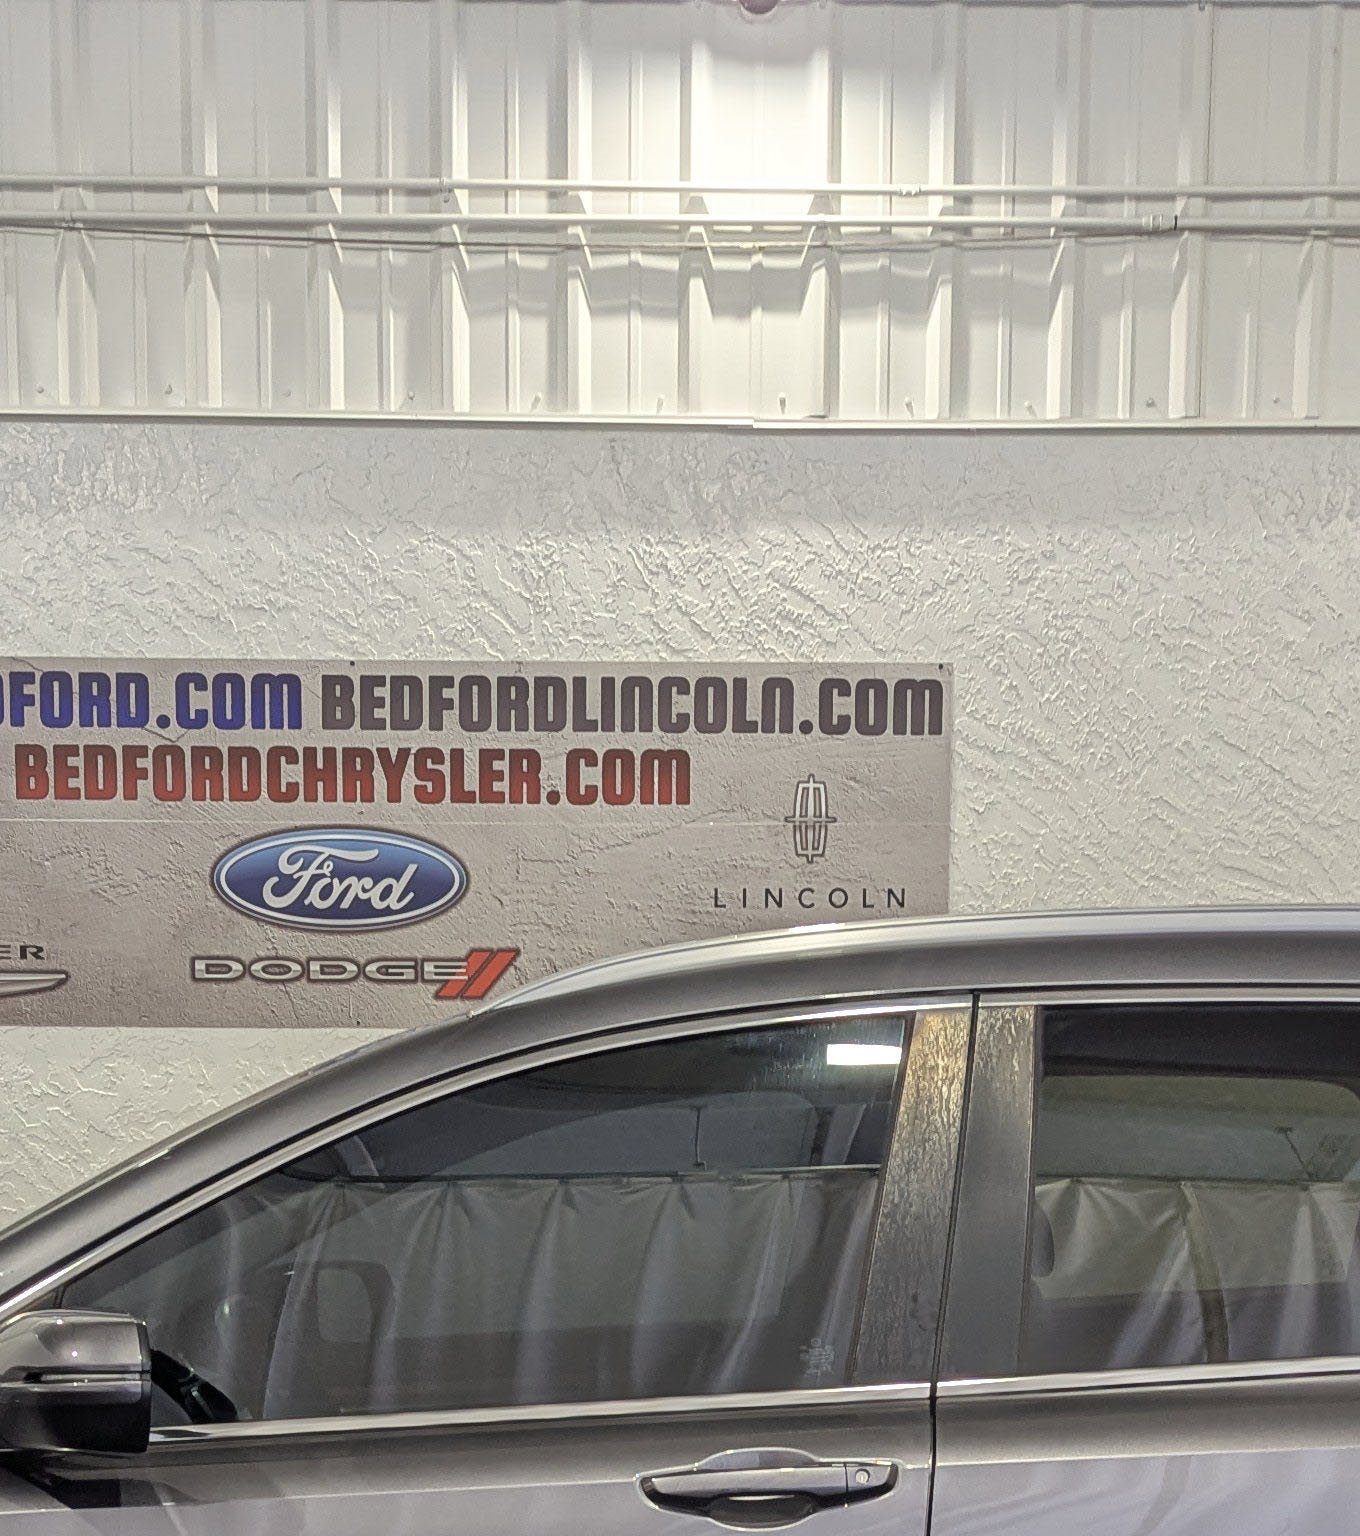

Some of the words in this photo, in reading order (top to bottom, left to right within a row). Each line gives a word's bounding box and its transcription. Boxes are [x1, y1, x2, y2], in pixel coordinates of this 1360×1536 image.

[321, 674, 944, 736] BEDFORDLINCOLN.COM
[15, 744, 691, 806] BEDFORDCHRYSLER.COM
[262, 844, 418, 910] Ford
[713, 887, 907, 909] LINCOLN
[193, 957, 469, 982] DODGE
